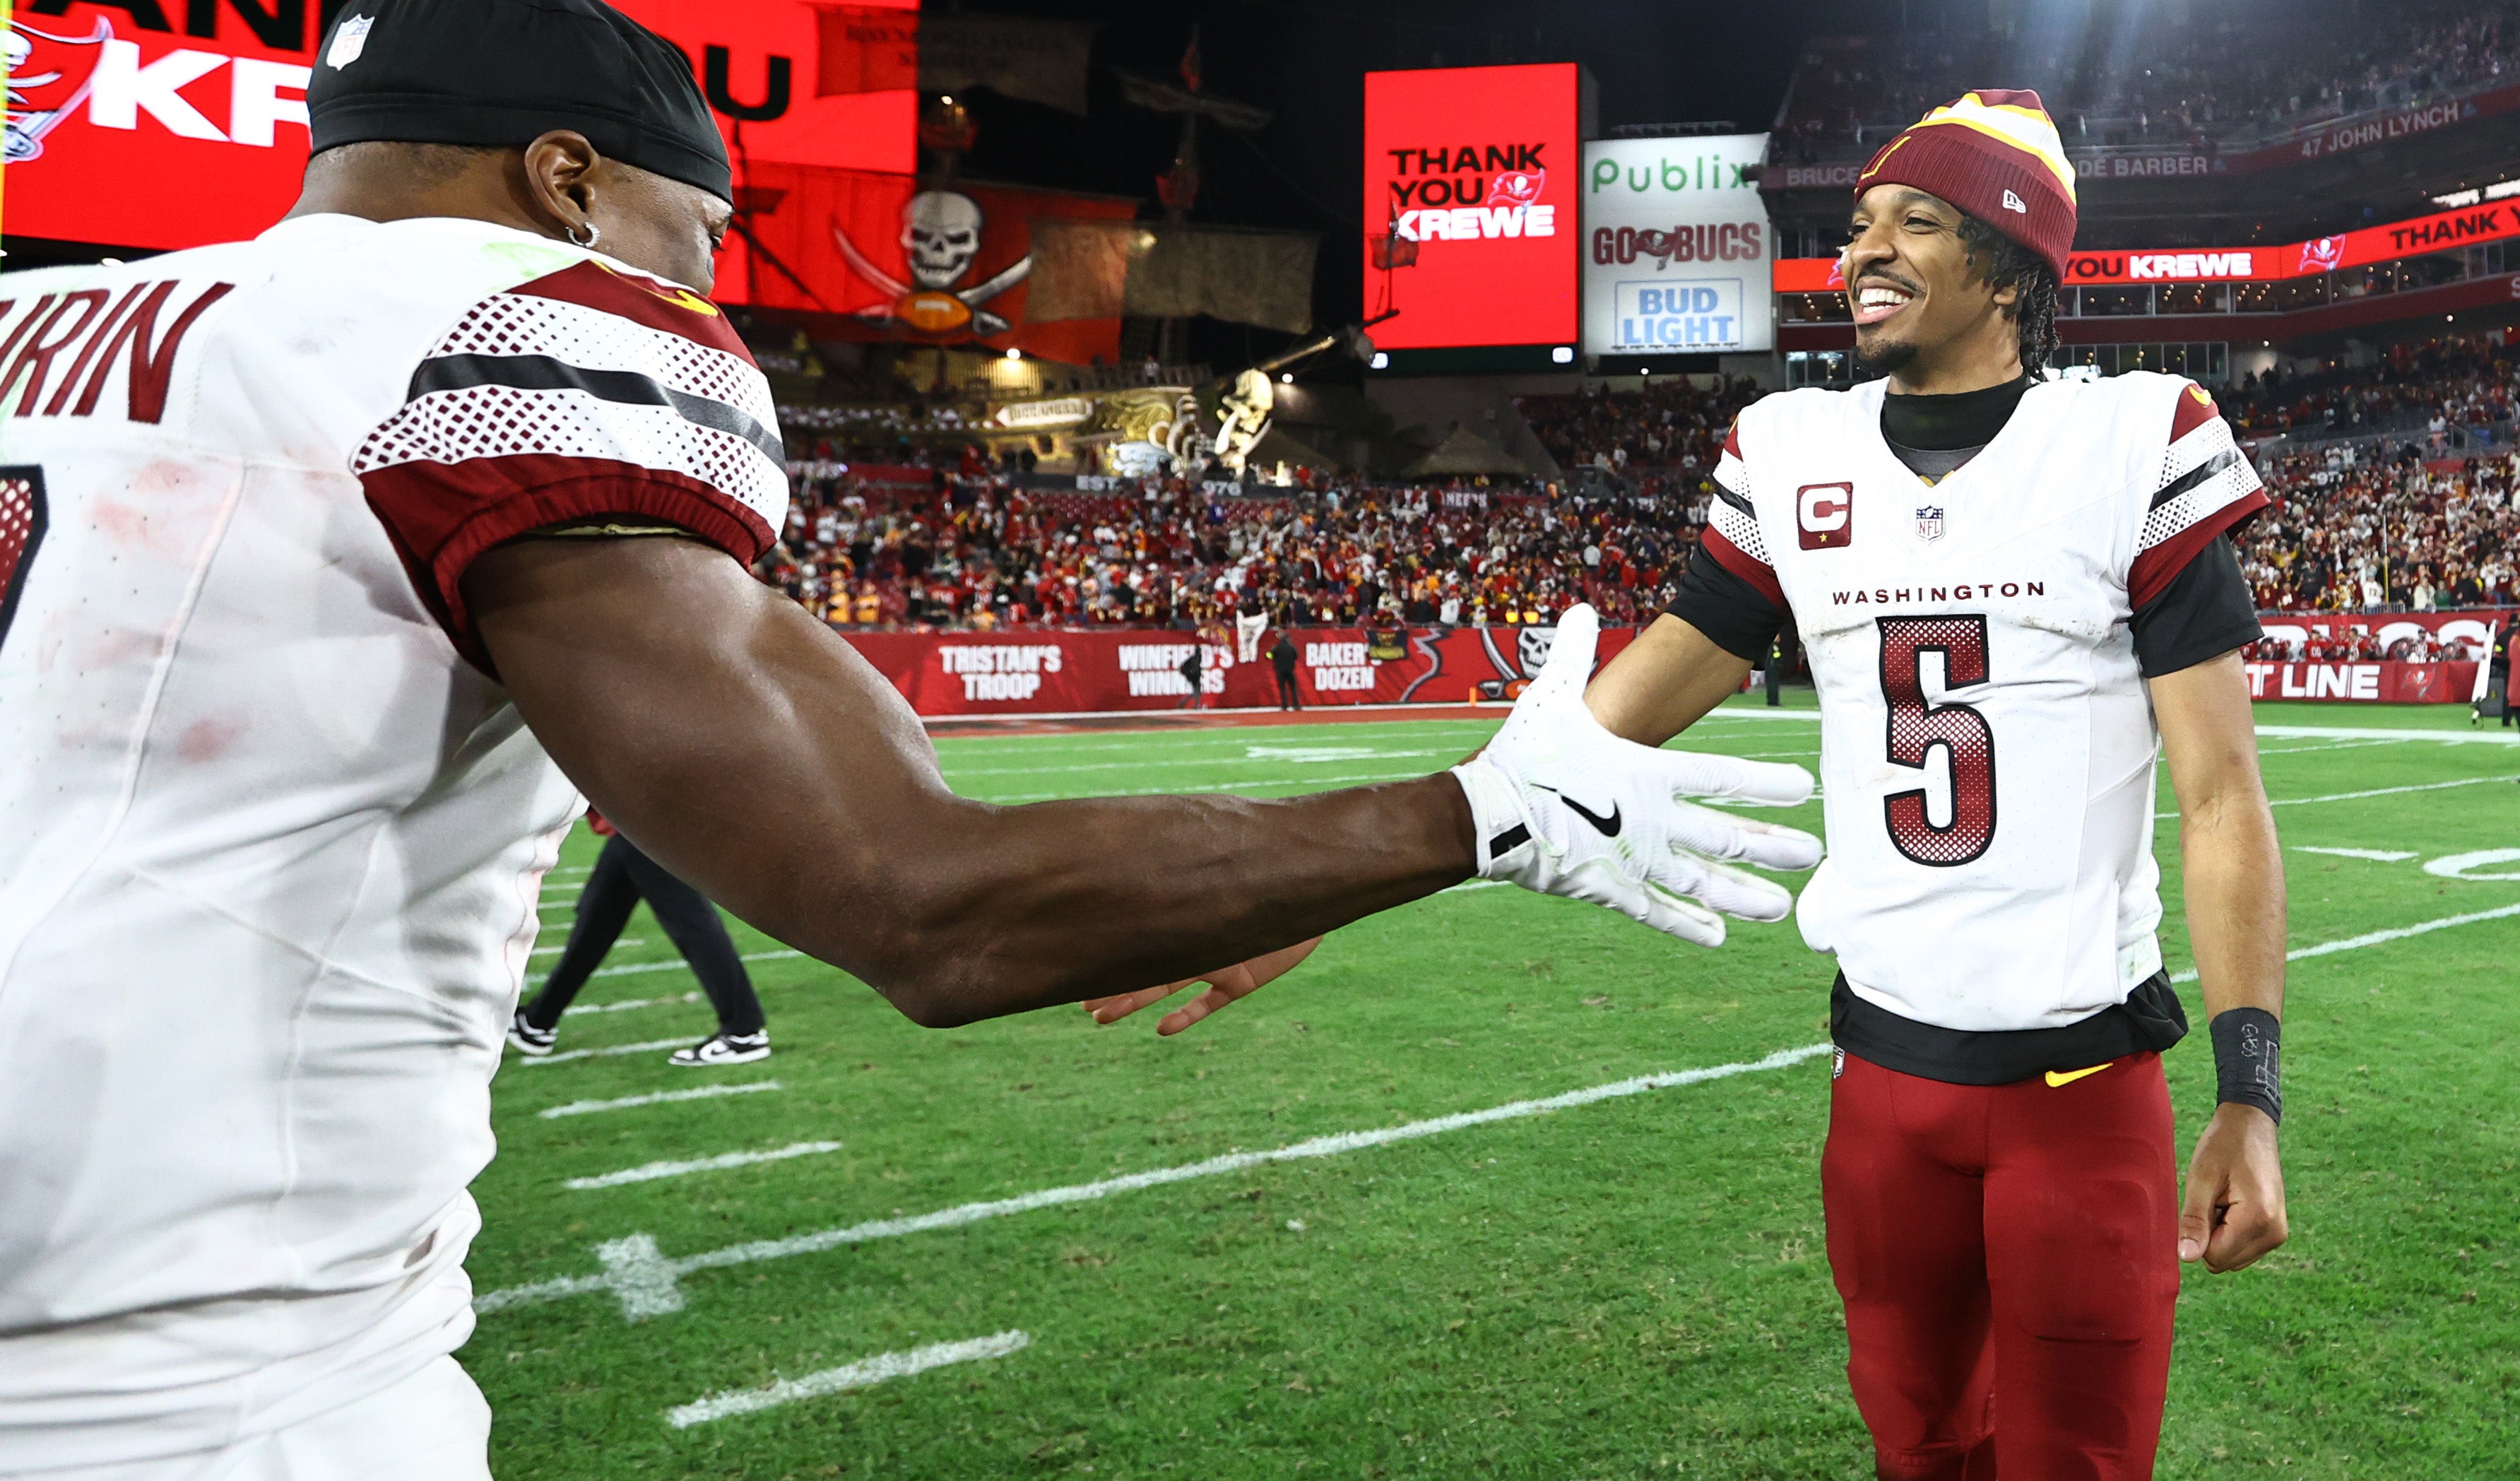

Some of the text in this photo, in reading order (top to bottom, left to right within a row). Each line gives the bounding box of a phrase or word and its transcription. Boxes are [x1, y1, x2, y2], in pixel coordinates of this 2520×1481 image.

[2302, 102, 2459, 156] 47 JOHN LYNCH
[1388, 143, 1546, 175] THANK
[2074, 156, 2208, 177] DE BARBER
[1592, 154, 1749, 193] Publix
[1787, 167, 1861, 186] BRUCE
[1390, 179, 1483, 207] YOU
[1674, 222, 1761, 262] BUCS
[2389, 209, 2500, 249] THANK
[2129, 252, 2252, 278] KREWE
[1639, 287, 1718, 315] BUD
[1623, 315, 1734, 344] LIGHT
[1799, 486, 1848, 533] C
[1918, 520, 1940, 536] NFL
[1833, 581, 2044, 605] WASHINGTON
[939, 645, 1062, 673] TRISTAN'S
[1306, 642, 1383, 667] BAKER'
[962, 673, 1041, 701] TROOP
[1315, 666, 1376, 691] DOZEN
[2282, 664, 2380, 700] LINE
[1876, 613, 1997, 868] 5
